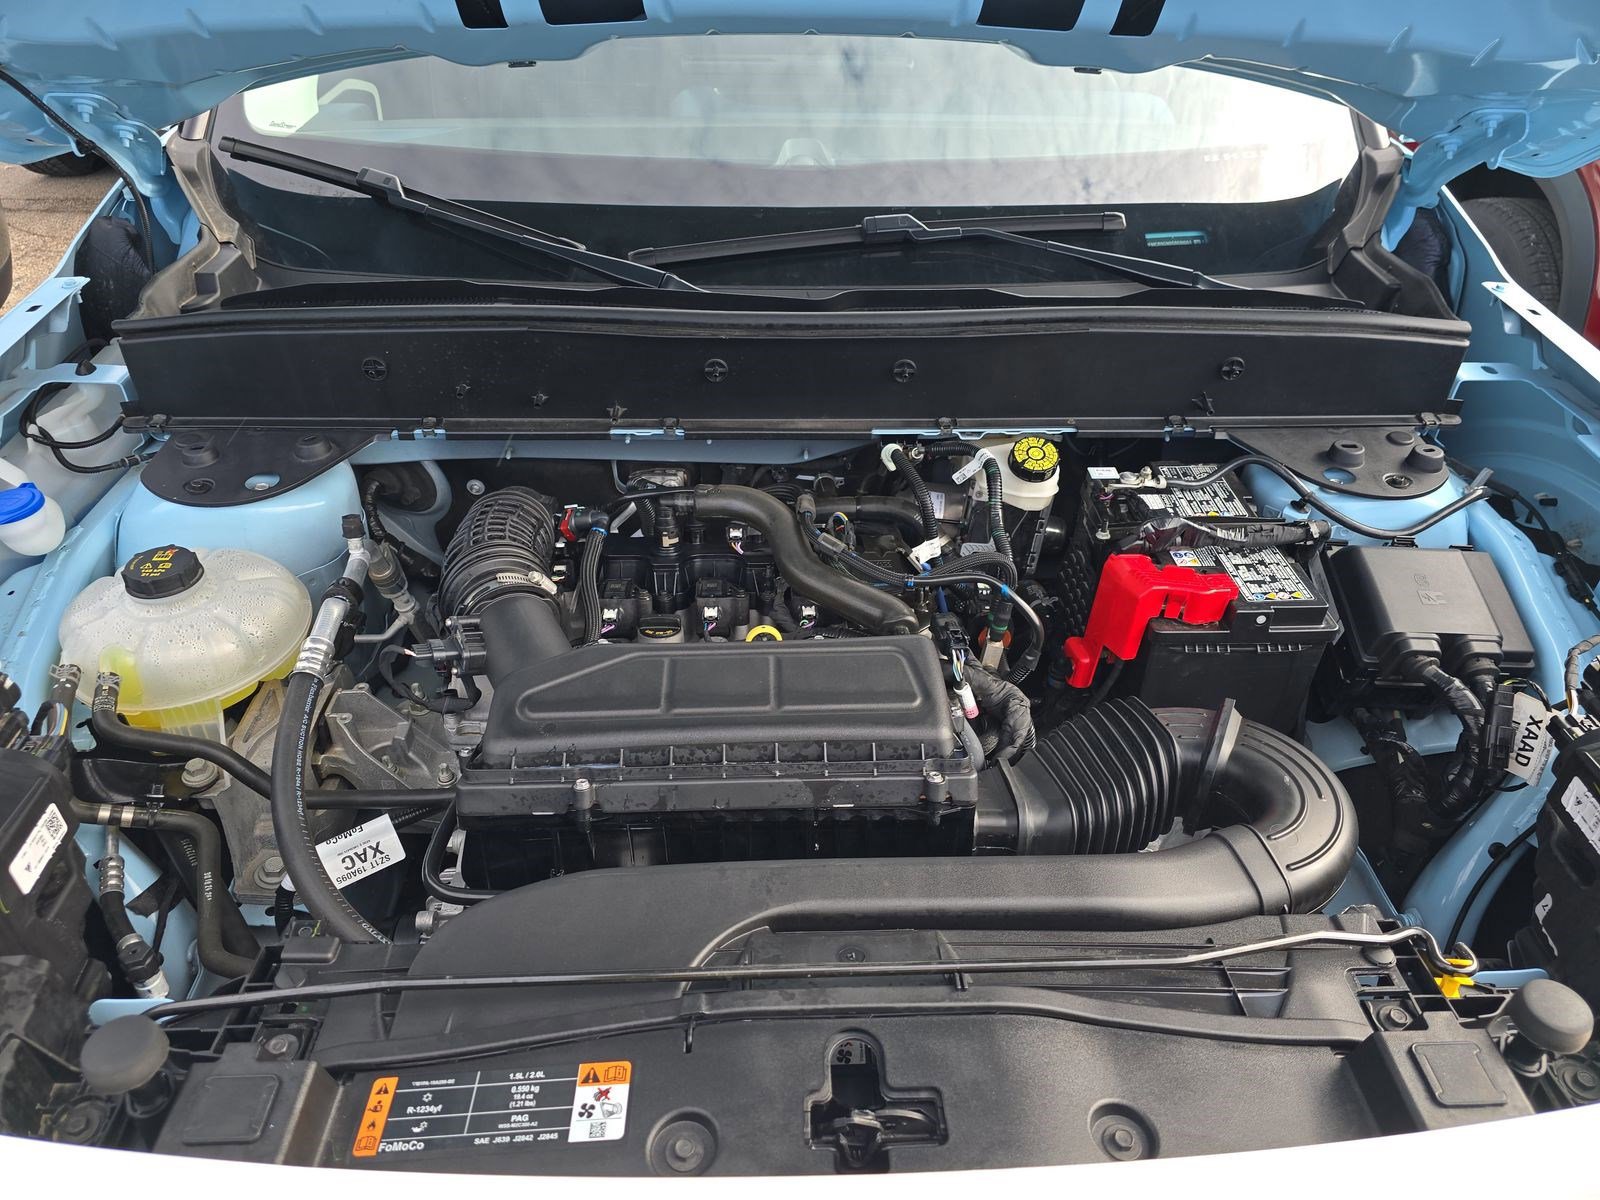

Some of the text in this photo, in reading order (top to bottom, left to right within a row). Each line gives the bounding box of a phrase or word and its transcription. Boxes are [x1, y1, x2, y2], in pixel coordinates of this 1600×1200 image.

[298, 724, 307, 750] SUCTION
[1515, 714, 1543, 767] XAAD
[325, 825, 364, 845] FoMoCo
[341, 841, 385, 871] XAC
[335, 854, 391, 885] SZ1T 19A095
[509, 1072, 525, 1080] 1.5L
[529, 1070, 545, 1079] 2.0L
[511, 1084, 540, 1094] 0.550 kg
[406, 1104, 443, 1114] R-1234yf
[509, 1099, 536, 1109] (1.21 lbs)
[511, 1114, 529, 1122] PAG
[378, 1140, 425, 1152] FoMoCo
[474, 1136, 490, 1145] SAE
